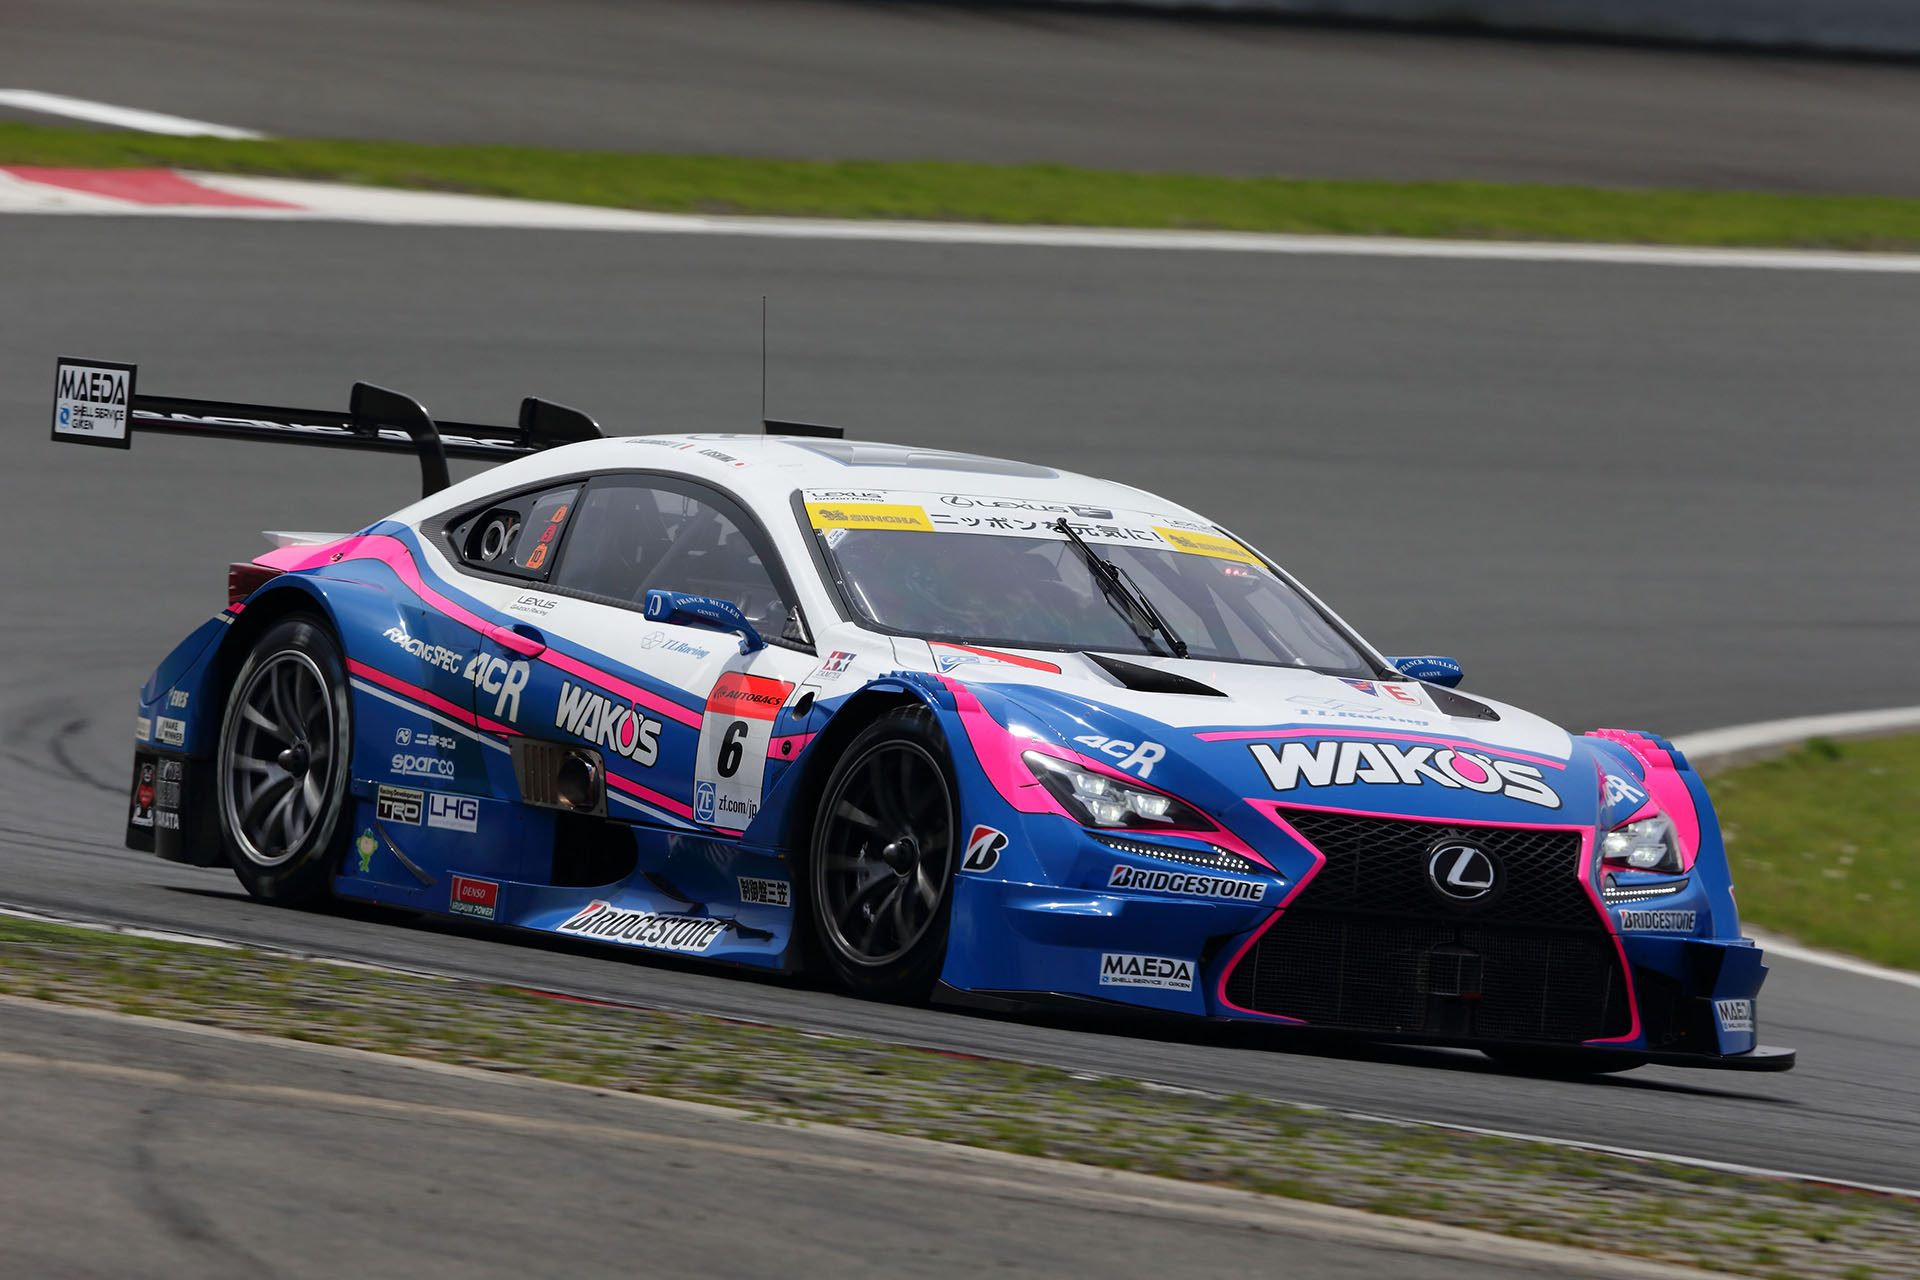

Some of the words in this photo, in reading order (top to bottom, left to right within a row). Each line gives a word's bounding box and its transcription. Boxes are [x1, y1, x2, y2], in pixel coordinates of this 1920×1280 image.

[58, 369, 126, 405] MAEDA
[811, 491, 883, 499] LEXUS
[976, 500, 1070, 512] LEXUS
[849, 513, 922, 526] SINGHA
[517, 595, 558, 610] LEXUS
[676, 597, 706, 607] FRANCK
[709, 599, 740, 620] MULLER
[697, 608, 720, 619] GENEVE
[1418, 671, 1443, 679] GENEVE
[1427, 658, 1460, 673] MULLER
[430, 644, 464, 675] SPEC
[463, 651, 531, 723] 4CR
[725, 689, 782, 706] AUTOBACS
[555, 680, 662, 768] WAKO'S
[717, 720, 749, 779] 6
[1072, 735, 1167, 779] 4CR
[390, 753, 455, 780] sparco
[1247, 741, 1564, 811] WAKO'S
[380, 798, 420, 822] TRD
[430, 795, 477, 821] LHG
[718, 794, 758, 820] zf.com/jp
[462, 886, 487, 899] DENSO
[1109, 866, 1264, 901] BRIDGESTONE
[473, 905, 494, 917] POWER
[1620, 910, 1696, 931] BRIDGESTONE
[562, 903, 728, 949] BRIDGESTONE
[1103, 955, 1192, 982] MAEDA
